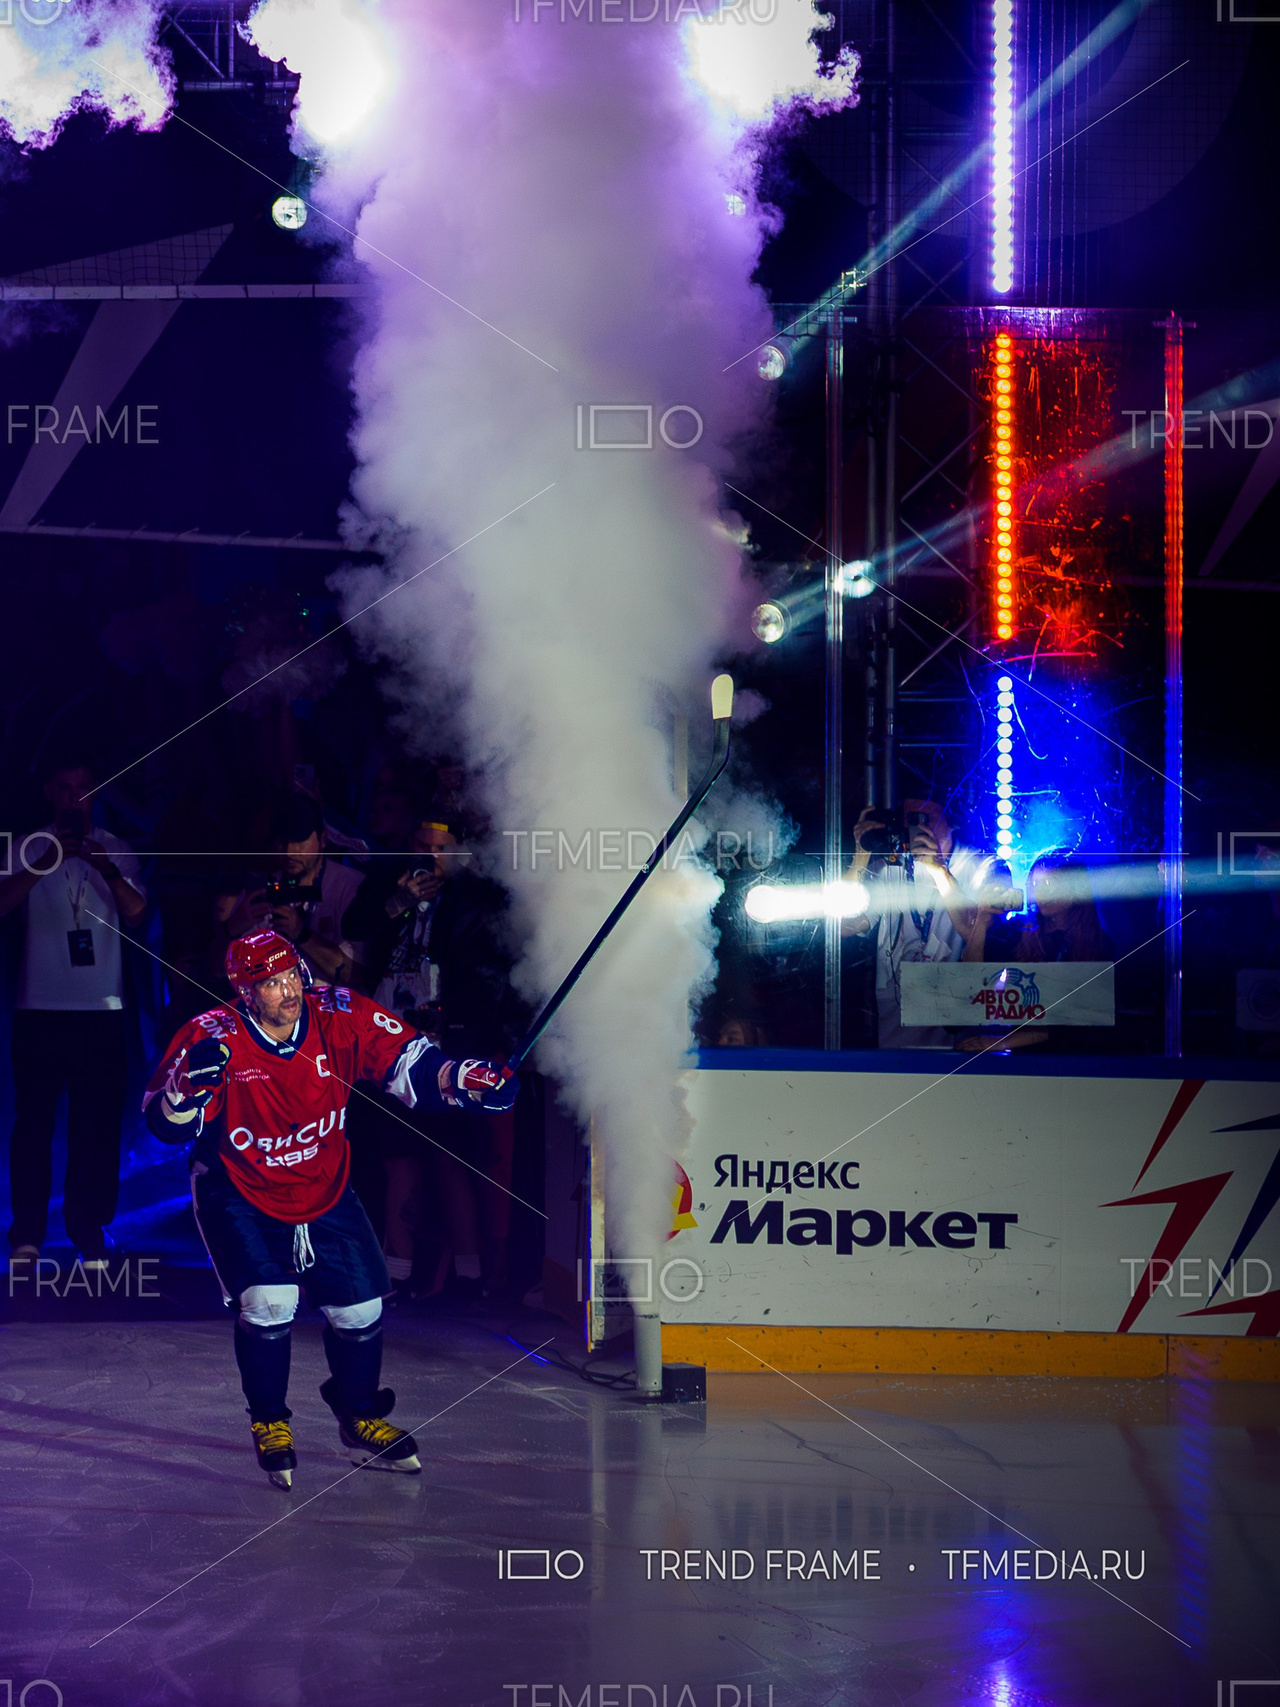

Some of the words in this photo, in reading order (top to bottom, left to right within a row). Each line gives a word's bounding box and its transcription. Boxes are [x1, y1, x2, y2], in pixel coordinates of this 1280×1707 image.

[970, 989, 1020, 1005] АВТО
[985, 1004, 1046, 1020] РАДИО
[315, 1053, 331, 1078] C
[713, 1154, 860, 1194] Яндекс
[709, 1200, 1019, 1255] Маркет
